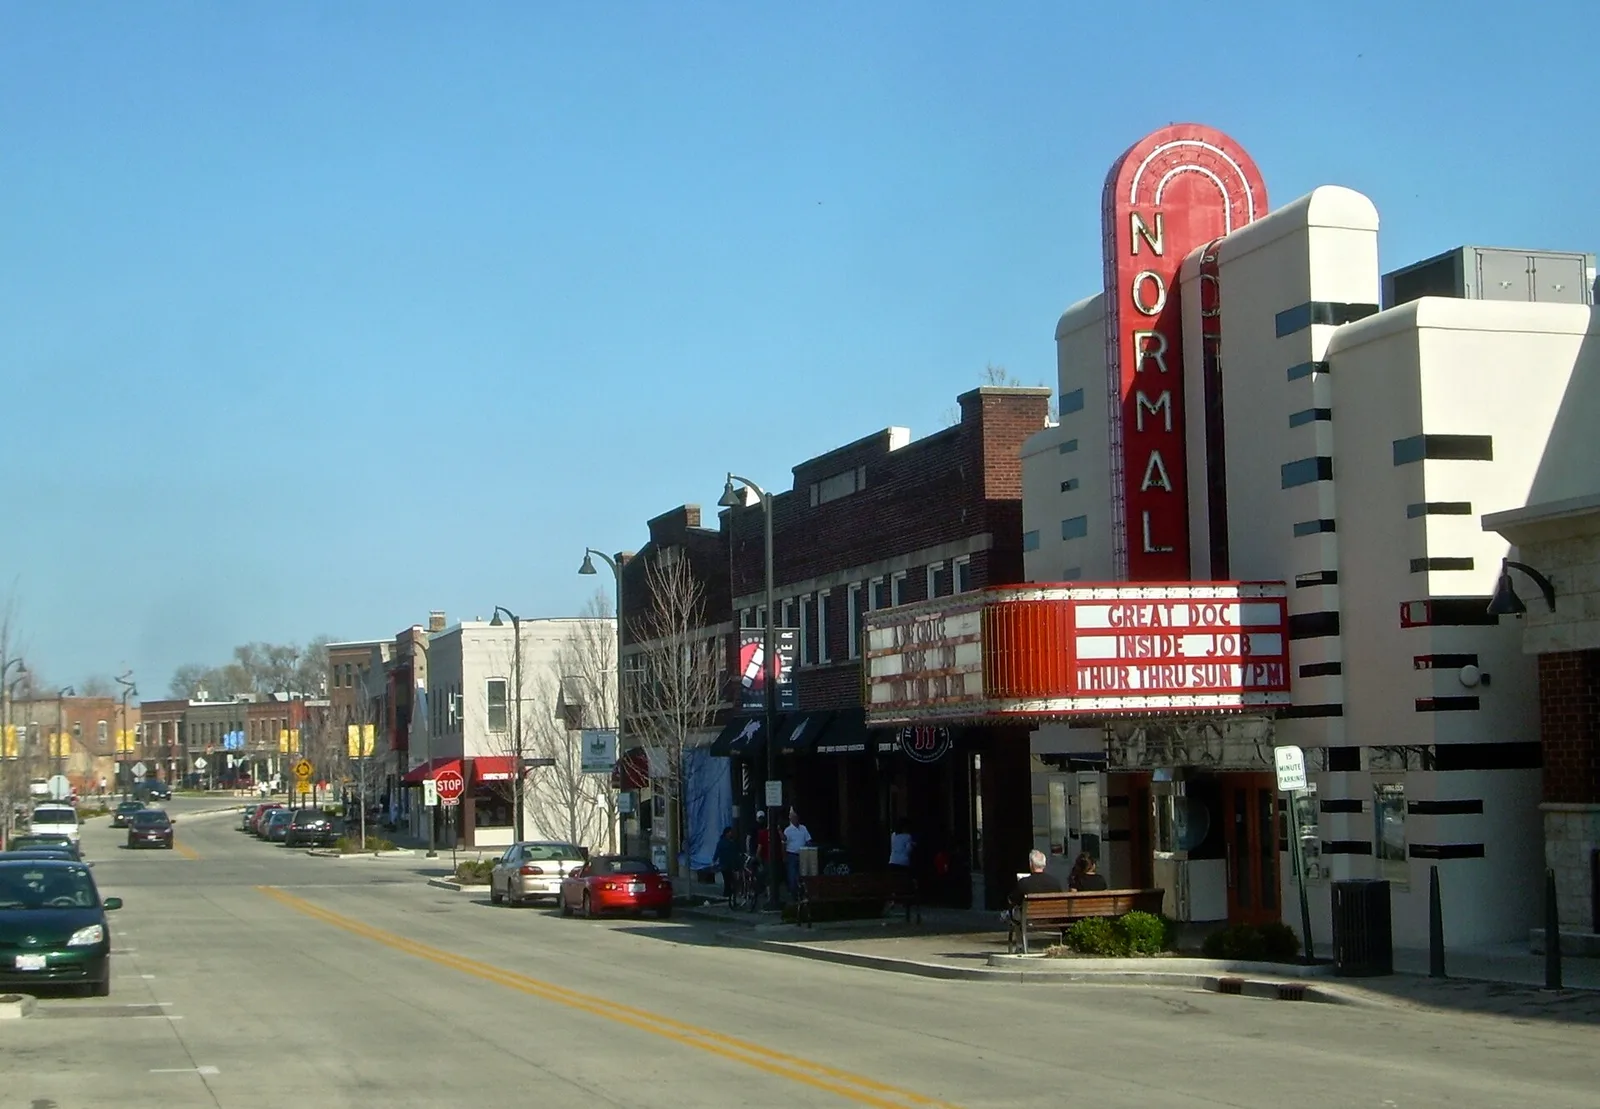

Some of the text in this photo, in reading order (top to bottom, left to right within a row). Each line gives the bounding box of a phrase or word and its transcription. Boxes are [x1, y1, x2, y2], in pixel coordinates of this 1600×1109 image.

[1129, 210, 1174, 553] NORMAL
[1108, 604, 1231, 627] GREAT DOC
[1116, 634, 1252, 659] INSIDE JOB
[781, 632, 793, 707] THEATER
[1077, 666, 1130, 690] THUR
[1137, 664, 1187, 688] THRU
[1191, 663, 1232, 687] SUN
[1279, 763, 1301, 772] MINUTE
[1279, 775, 1305, 783] PARKING
[437, 779, 461, 791] STOP
